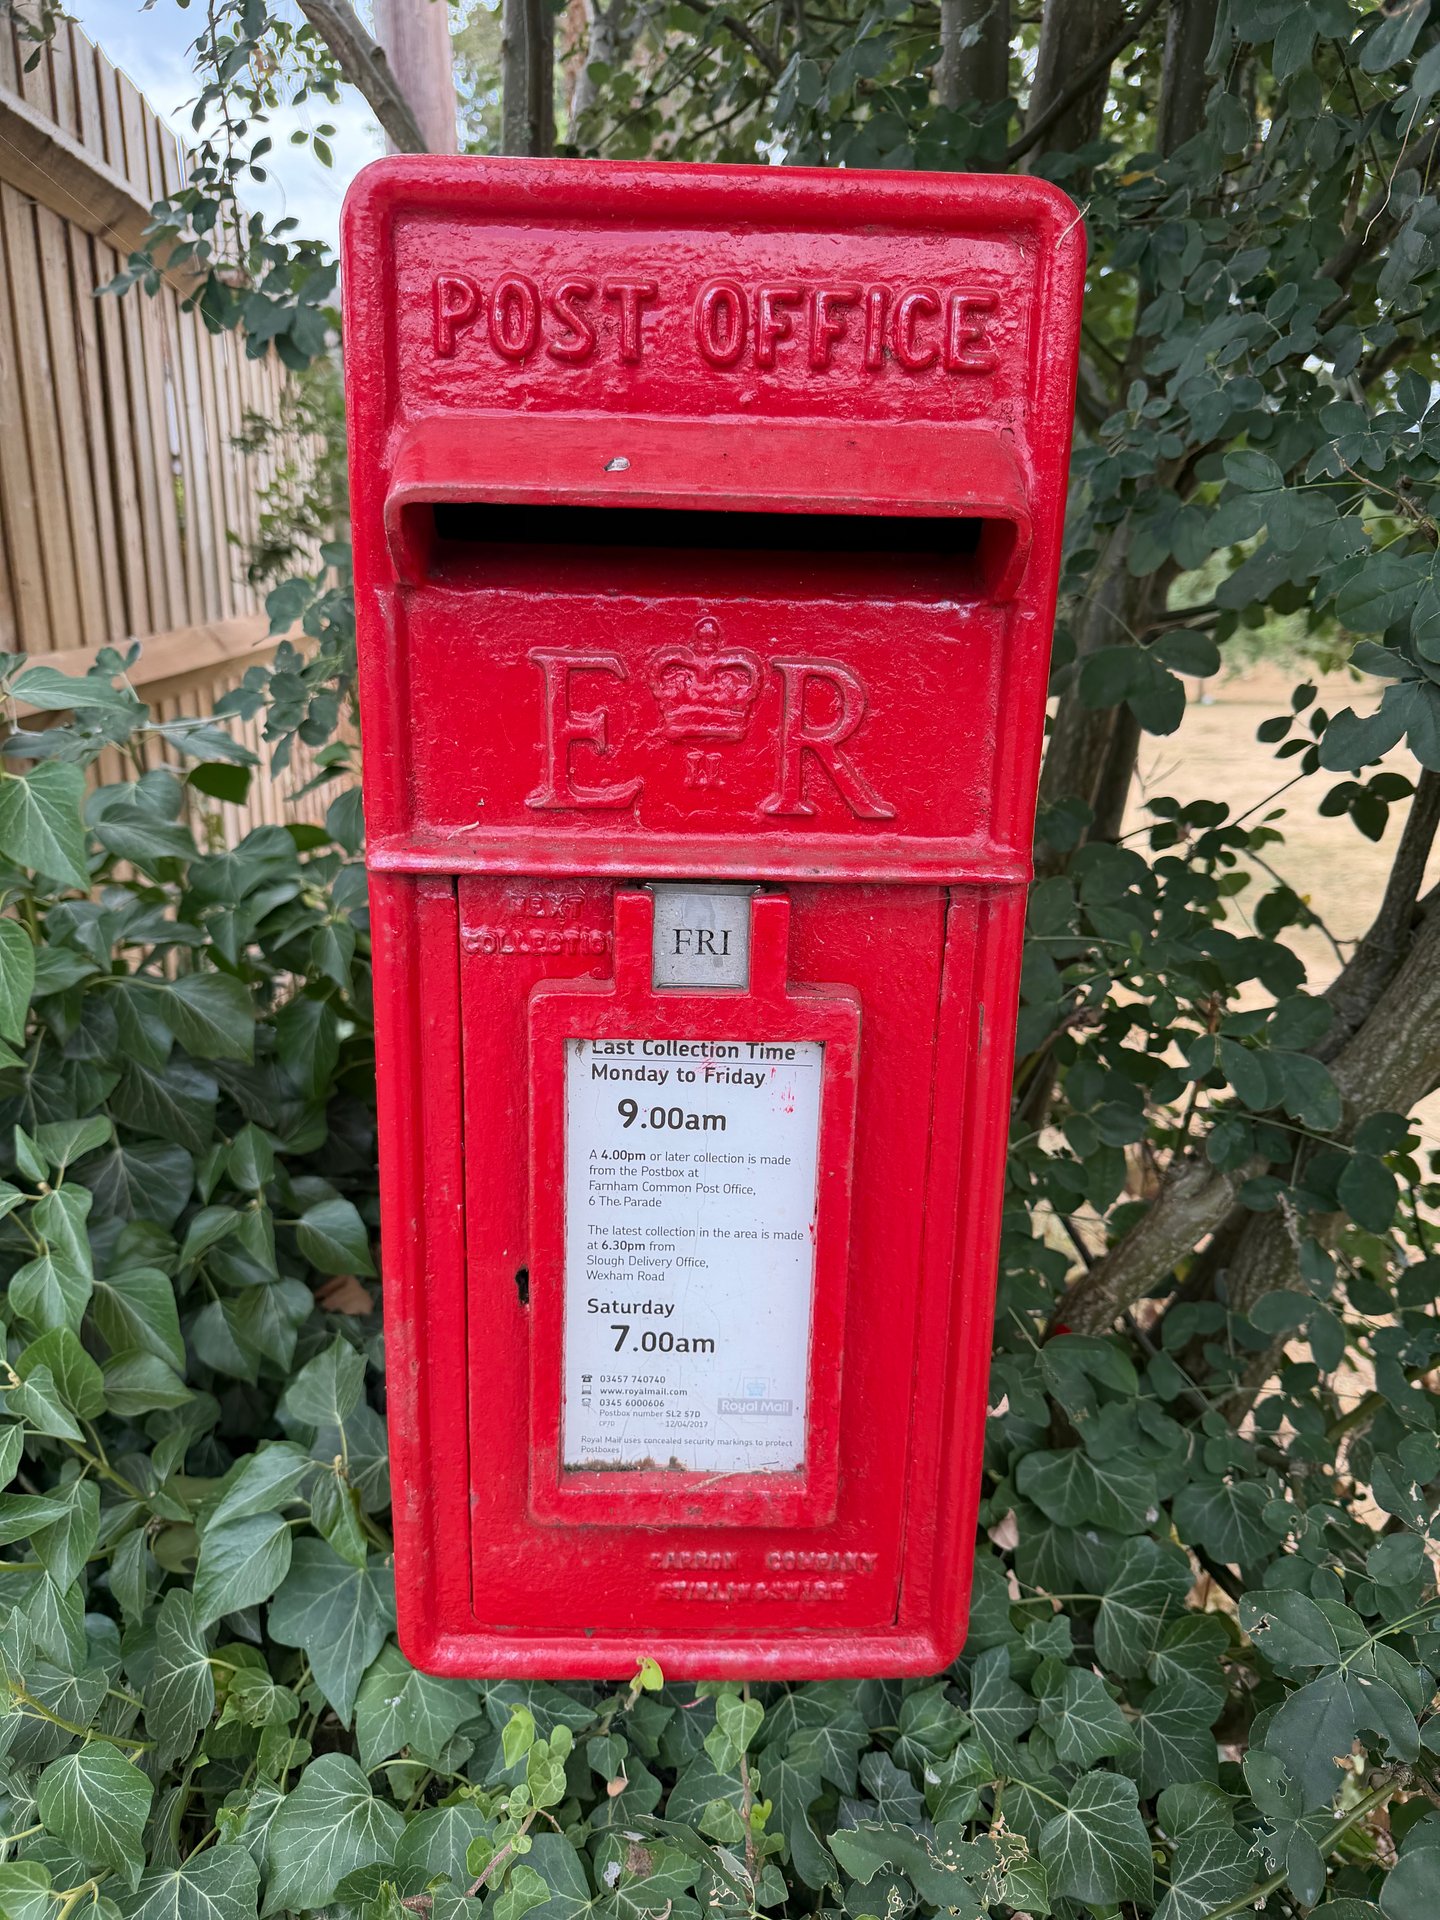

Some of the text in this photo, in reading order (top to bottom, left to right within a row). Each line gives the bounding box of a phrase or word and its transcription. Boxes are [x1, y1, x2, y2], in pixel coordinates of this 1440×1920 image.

[436, 271, 1002, 374] POST OFFICE
[525, 646, 898, 819] E R
[672, 928, 733, 956] FRI
[592, 1039, 797, 1062] Last Collection Time
[591, 1062, 766, 1089] Monday to Friday
[617, 1098, 727, 1132] 9.00am
[588, 1148, 792, 1166] A 4.00pm or later collection is made
[589, 1164, 700, 1178] from the Postbox at
[588, 1179, 757, 1196] Farnham Common Post Office,
[588, 1195, 663, 1208] 6 The Parade
[587, 1223, 804, 1241] The latest collection in the area is made
[586, 1239, 676, 1253] at 6.30pm from
[586, 1254, 709, 1269] Slough Delivery Office,
[585, 1269, 665, 1282] Wexham Road
[586, 1297, 676, 1320] Saturday
[609, 1324, 715, 1354] 7.00am
[599, 1374, 666, 1384] 03457 740740
[599, 1387, 688, 1397] www.royalmail.com
[599, 1398, 665, 1408] 0345 6000606
[721, 1399, 790, 1414] Royal Mail
[599, 1409, 631, 1417] Postbox
[632, 1410, 663, 1418] number
[665, 1409, 682, 1418] SL2
[666, 1420, 708, 1428] 12/04/2017
[581, 1436, 604, 1446] Royal
[604, 1436, 622, 1444] Mail
[643, 1437, 682, 1445] concealed
[684, 1438, 715, 1447] security
[717, 1438, 753, 1447] markings
[580, 1445, 620, 1454] Postboxes
